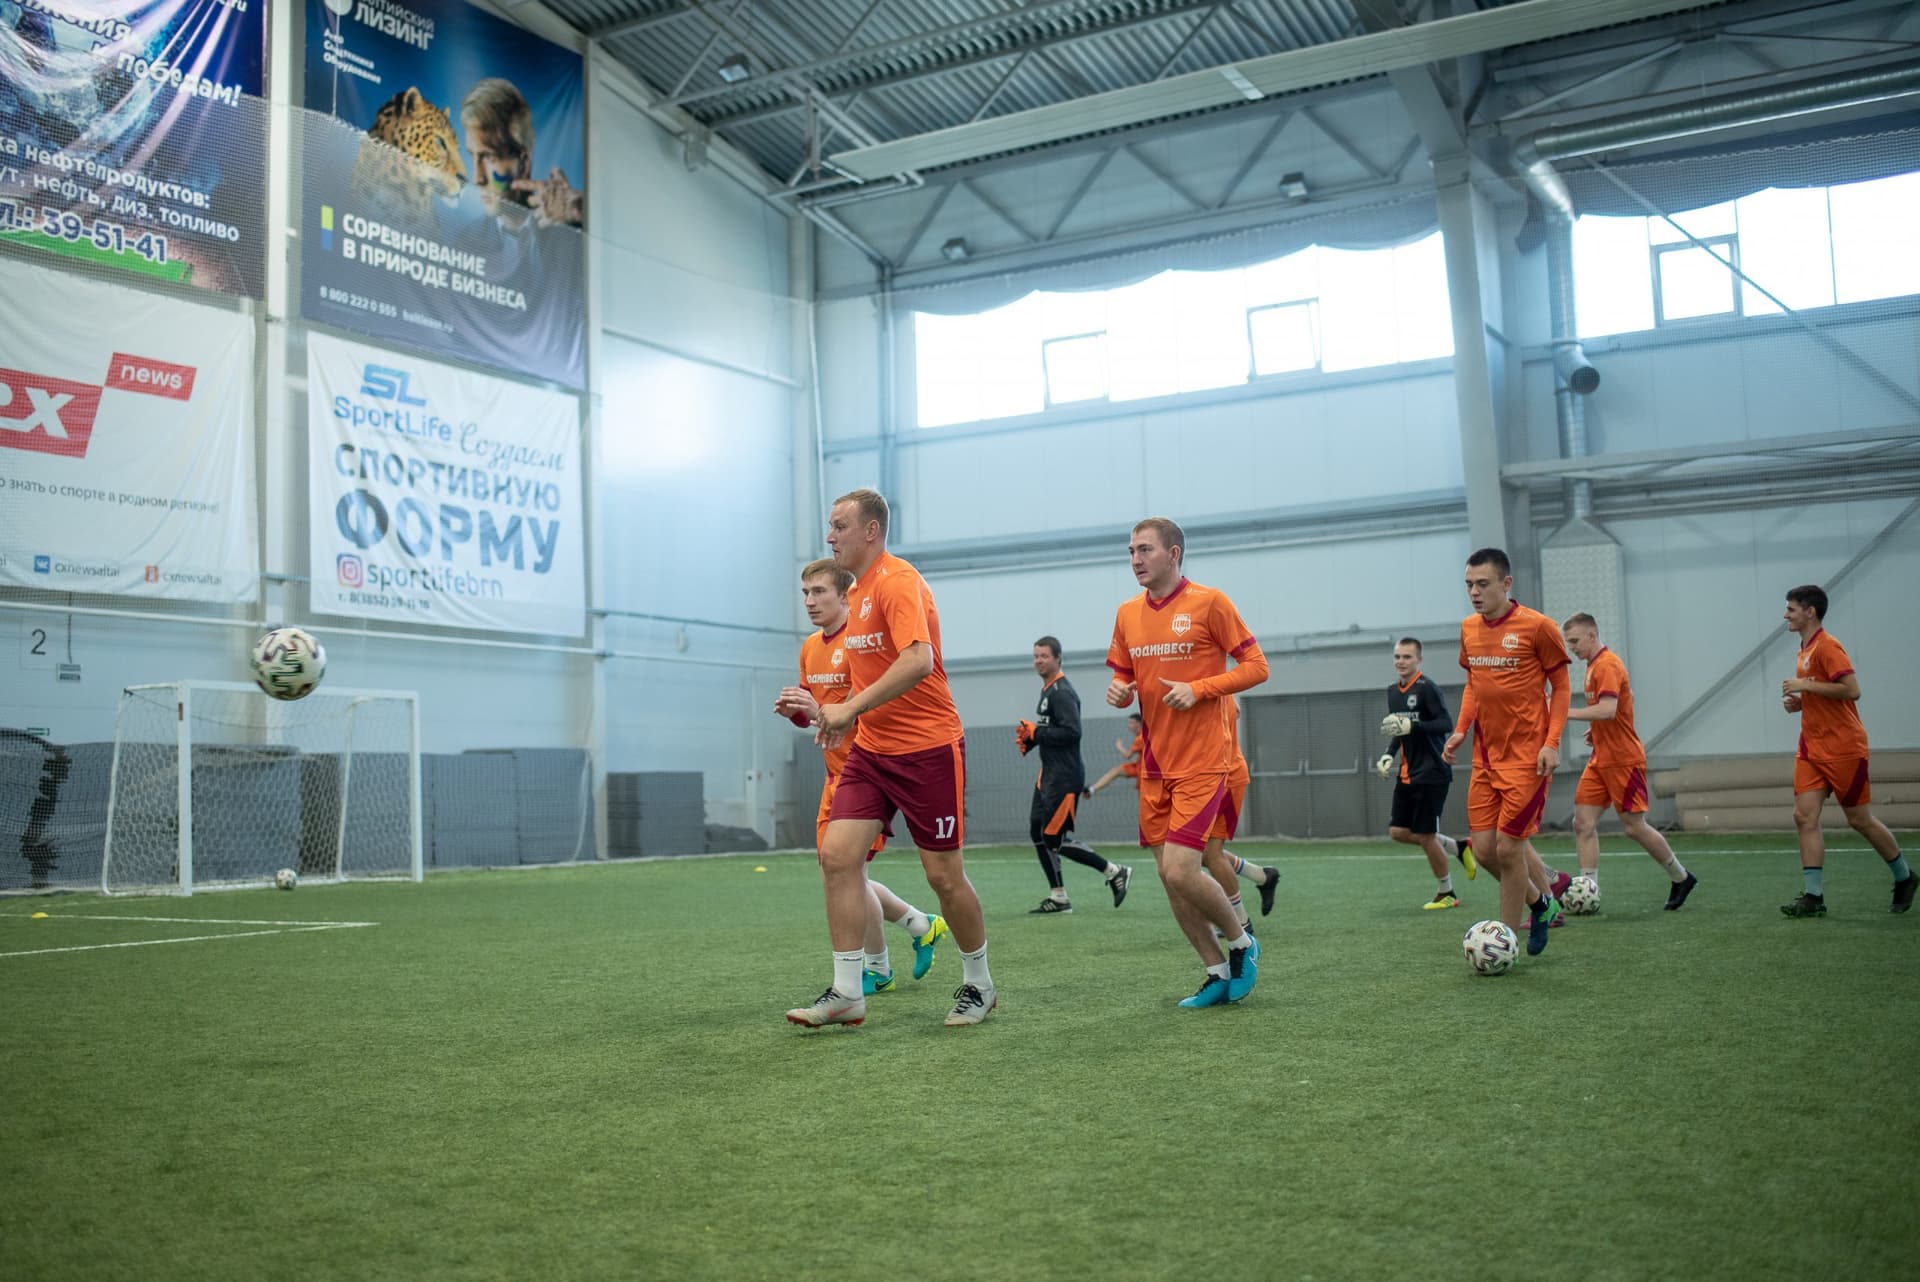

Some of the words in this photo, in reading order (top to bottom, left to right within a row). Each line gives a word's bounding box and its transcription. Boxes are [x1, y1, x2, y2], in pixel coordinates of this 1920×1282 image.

[354, 1, 434, 51] ЛИЗИНГ
[117, 52, 242, 107] победам!
[25, 143, 211, 210] нефтепродуктов:
[33, 173, 107, 209] нефть,
[111, 194, 154, 220] диз.
[159, 206, 240, 243] топливо
[41, 205, 169, 265] 39-51-41
[342, 213, 487, 278] СОРЕВНОВАНИЕ
[342, 238, 357, 261] В
[360, 243, 449, 289] ПРИРОДЕ
[451, 272, 528, 312] БИЗНЕСА
[120, 363, 183, 391] news
[359, 363, 428, 408] SL
[334, 395, 453, 442] SportLife
[8, 477, 46, 494] знать
[48, 484, 58, 495] о
[60, 484, 106, 501] спорте
[118, 492, 169, 509] родном
[335, 442, 562, 513] СПОРТИВНУЮ
[335, 487, 562, 575] ФОРМУ
[30, 628, 47, 656] 2
[934, 815, 956, 839] 17
